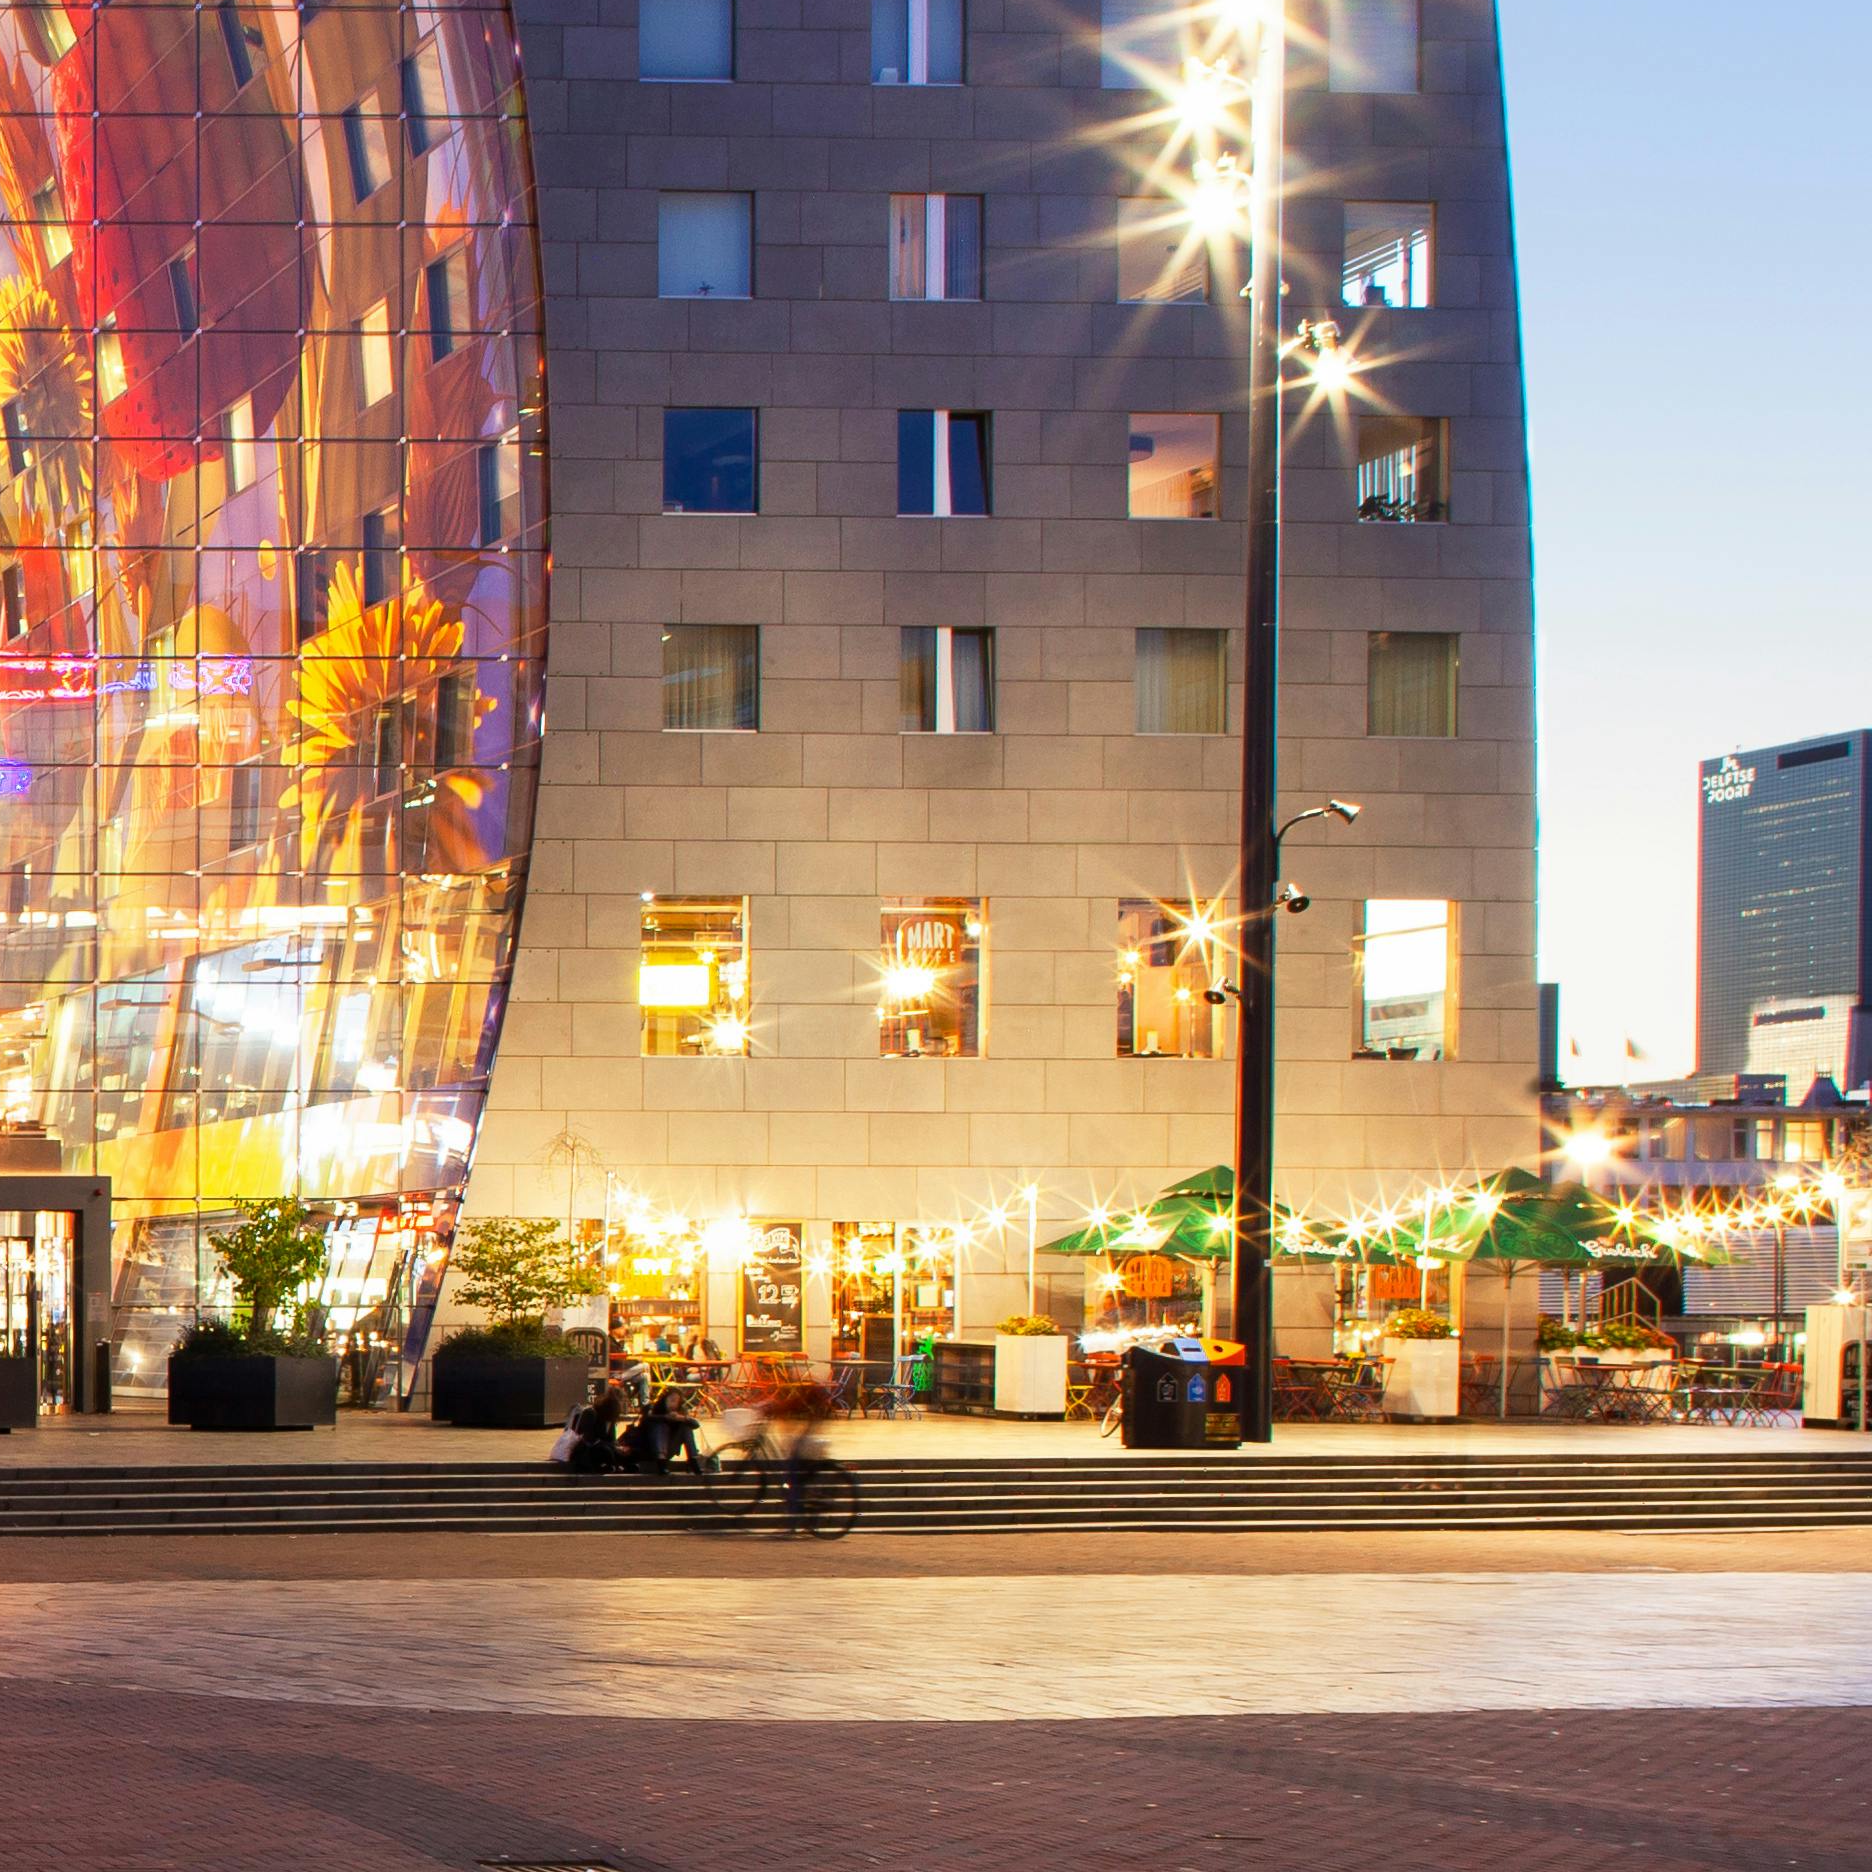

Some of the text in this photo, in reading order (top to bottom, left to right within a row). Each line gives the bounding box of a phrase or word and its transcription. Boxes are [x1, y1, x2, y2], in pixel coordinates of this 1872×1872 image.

[1702, 767, 1758, 791] DELFTSE
[1707, 783, 1753, 804] POORT
[907, 921, 955, 950] MART
